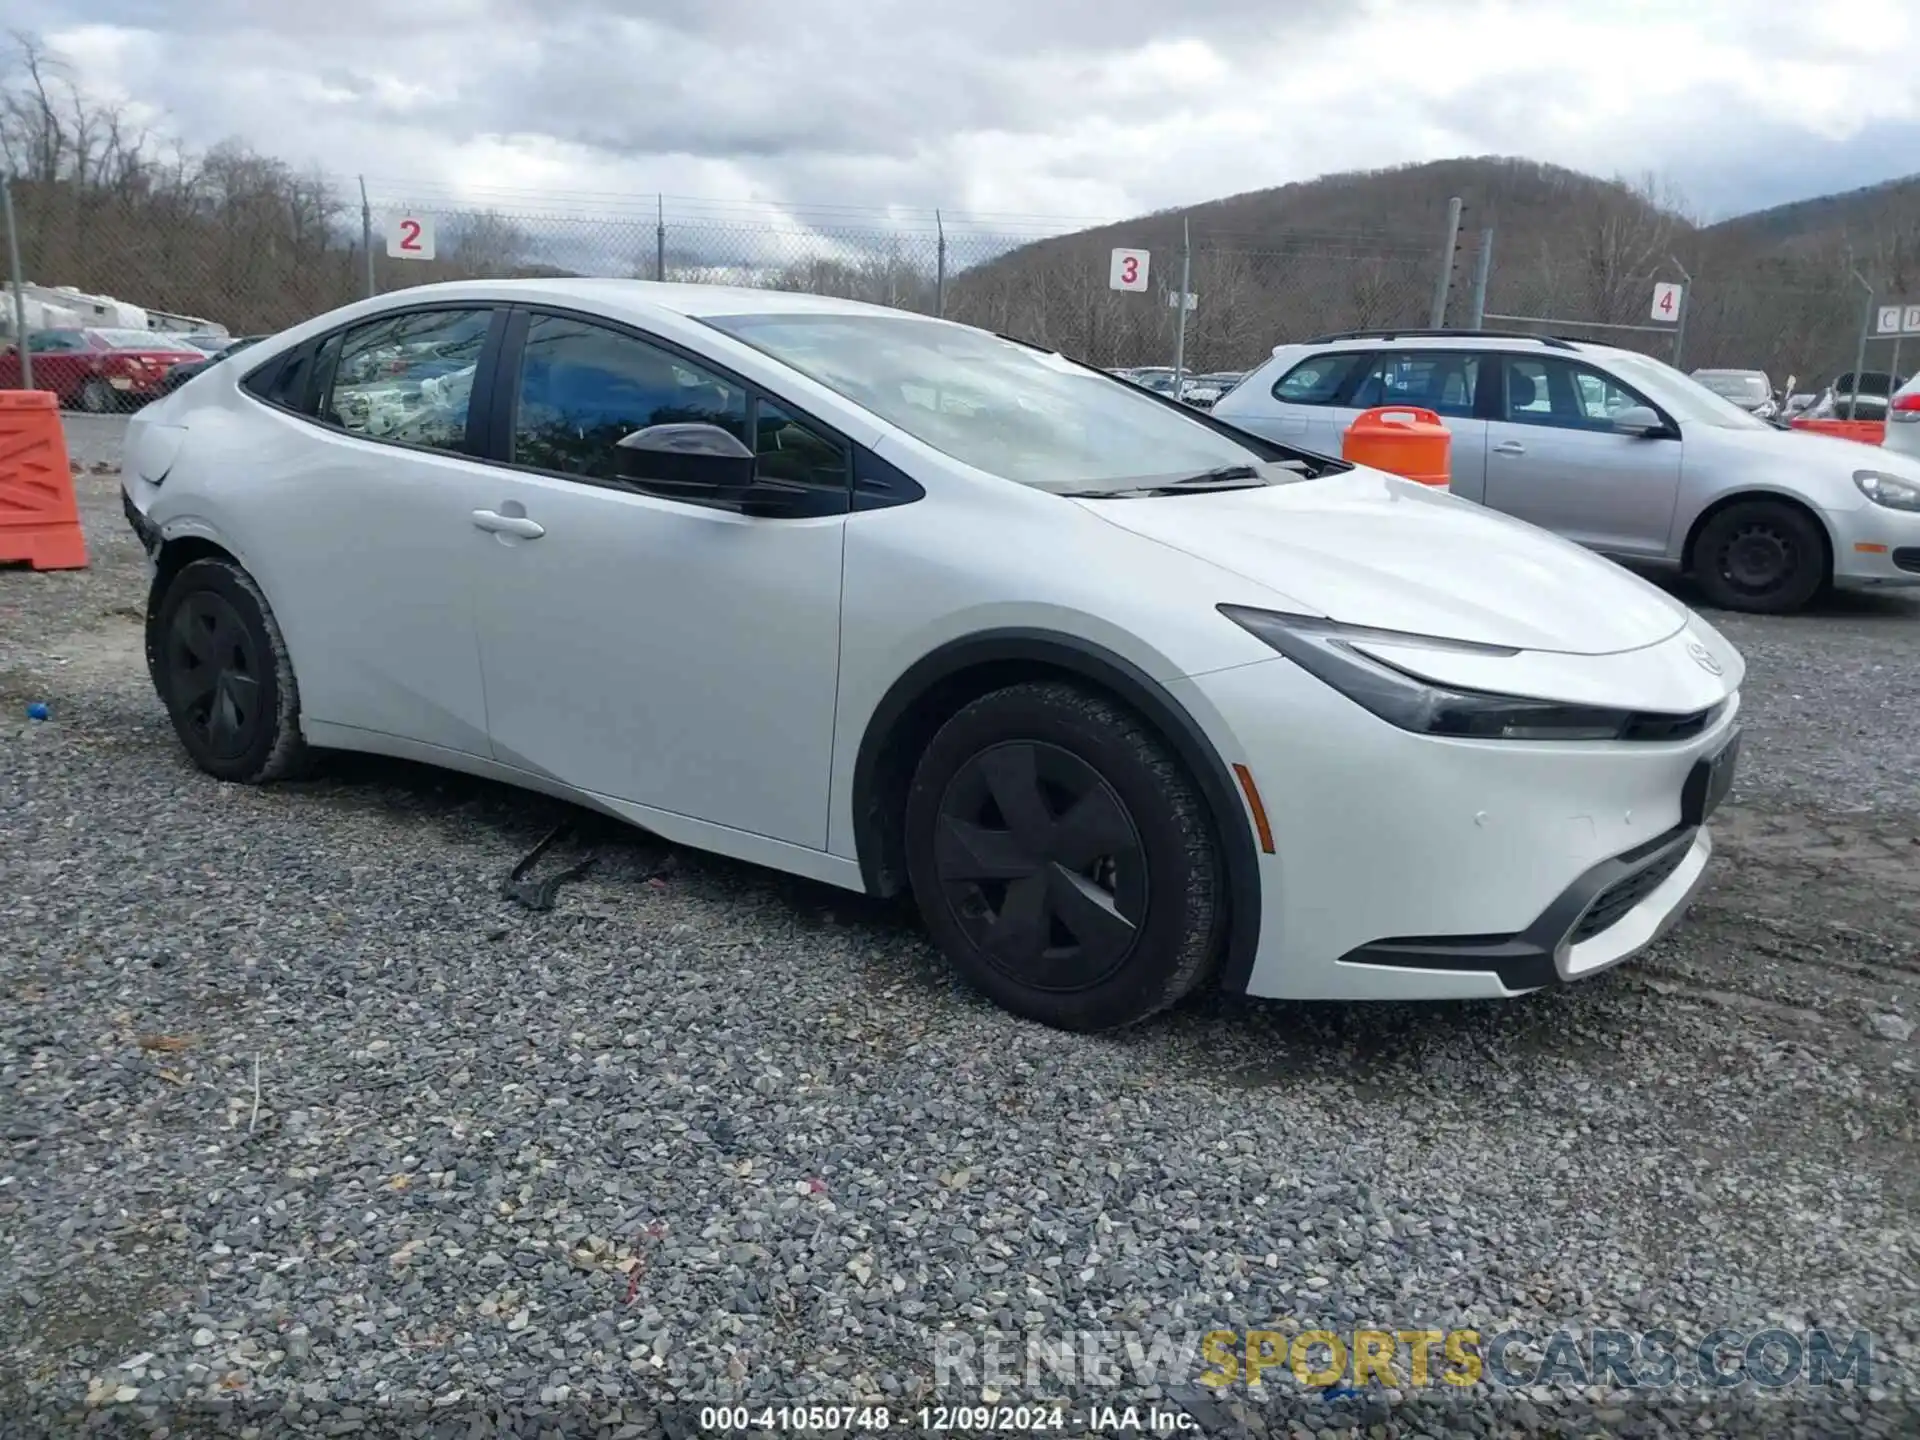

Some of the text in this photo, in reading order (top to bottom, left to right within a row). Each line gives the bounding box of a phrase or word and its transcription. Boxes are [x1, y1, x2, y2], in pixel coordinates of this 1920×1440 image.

[400, 220, 422, 250] 2
[1121, 256, 1139, 284] 3
[1660, 290, 1673, 315] 4
[1882, 310, 1897, 328] C
